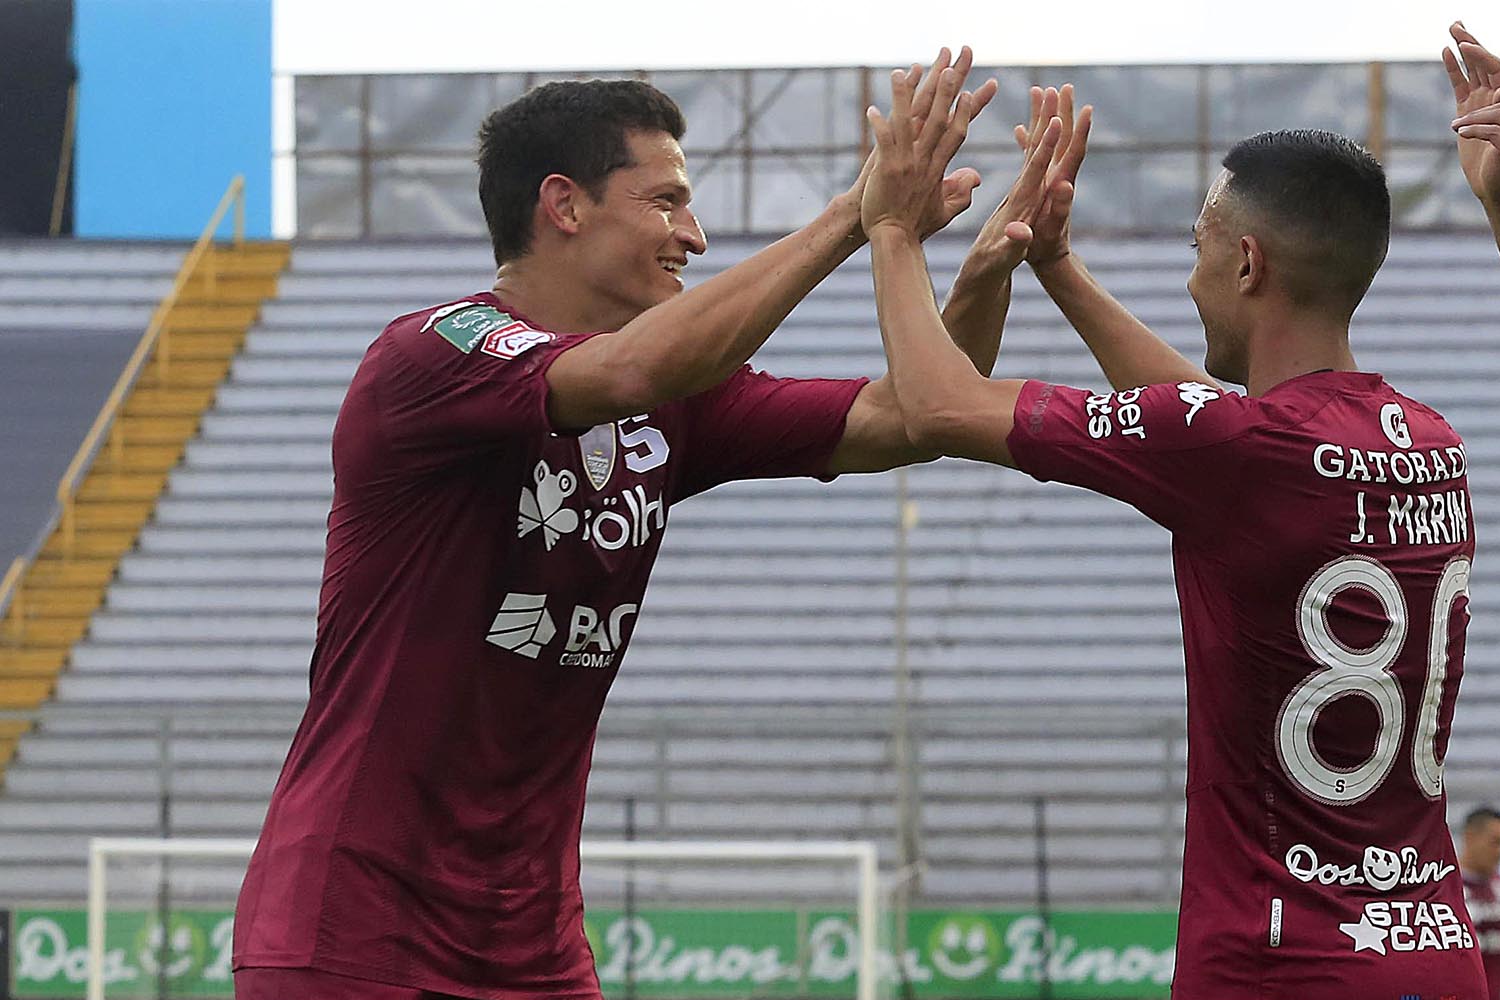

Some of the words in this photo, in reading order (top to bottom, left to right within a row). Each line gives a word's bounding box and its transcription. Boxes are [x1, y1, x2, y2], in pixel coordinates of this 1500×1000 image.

[1085, 390, 1113, 439] ats
[1116, 385, 1149, 440] ber
[1313, 442, 1469, 485] GATORAD
[1350, 491, 1375, 544] J.
[1388, 488, 1469, 545] MARIN
[1274, 553, 1473, 807] 80
[1400, 846, 1456, 885] Pin
[1364, 901, 1460, 928] STAR
[1390, 924, 1475, 951] CARS
[600, 915, 798, 984] Pinos
[808, 915, 934, 984] Ds
